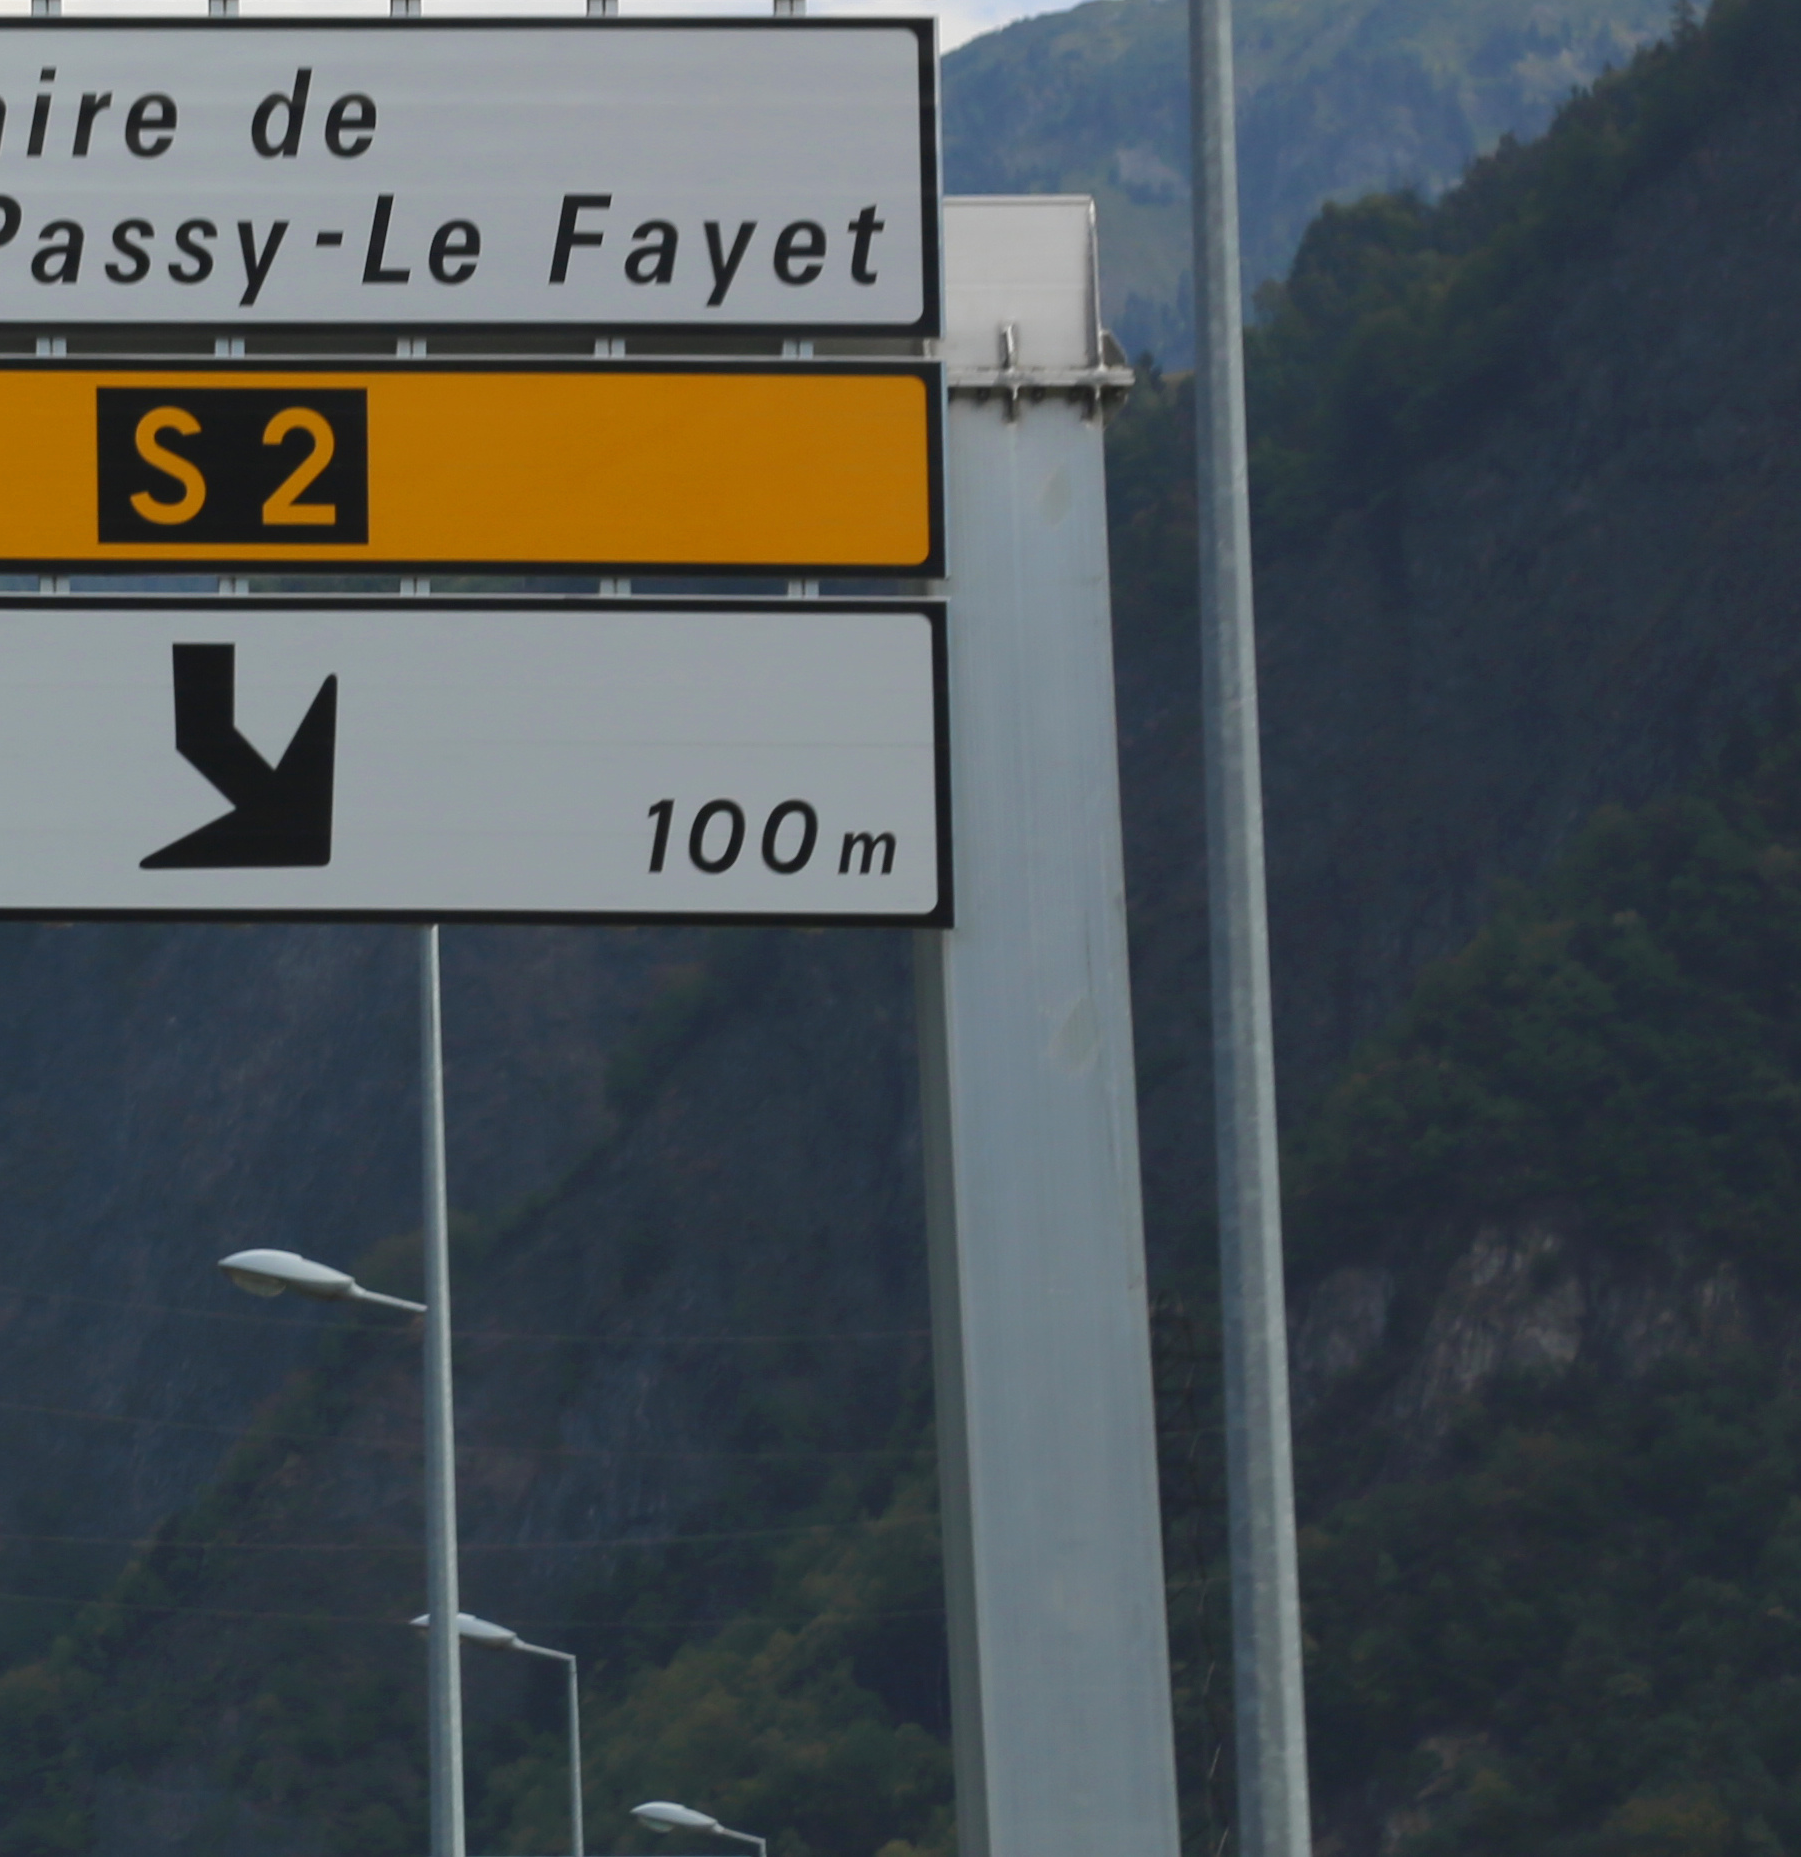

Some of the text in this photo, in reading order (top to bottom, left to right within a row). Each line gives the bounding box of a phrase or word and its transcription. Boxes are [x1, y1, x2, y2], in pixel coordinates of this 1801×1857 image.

[250, 67, 378, 160] de
[547, 193, 886, 308] Fayet
[129, 405, 337, 526] S 2
[647, 798, 897, 876] 100 m
